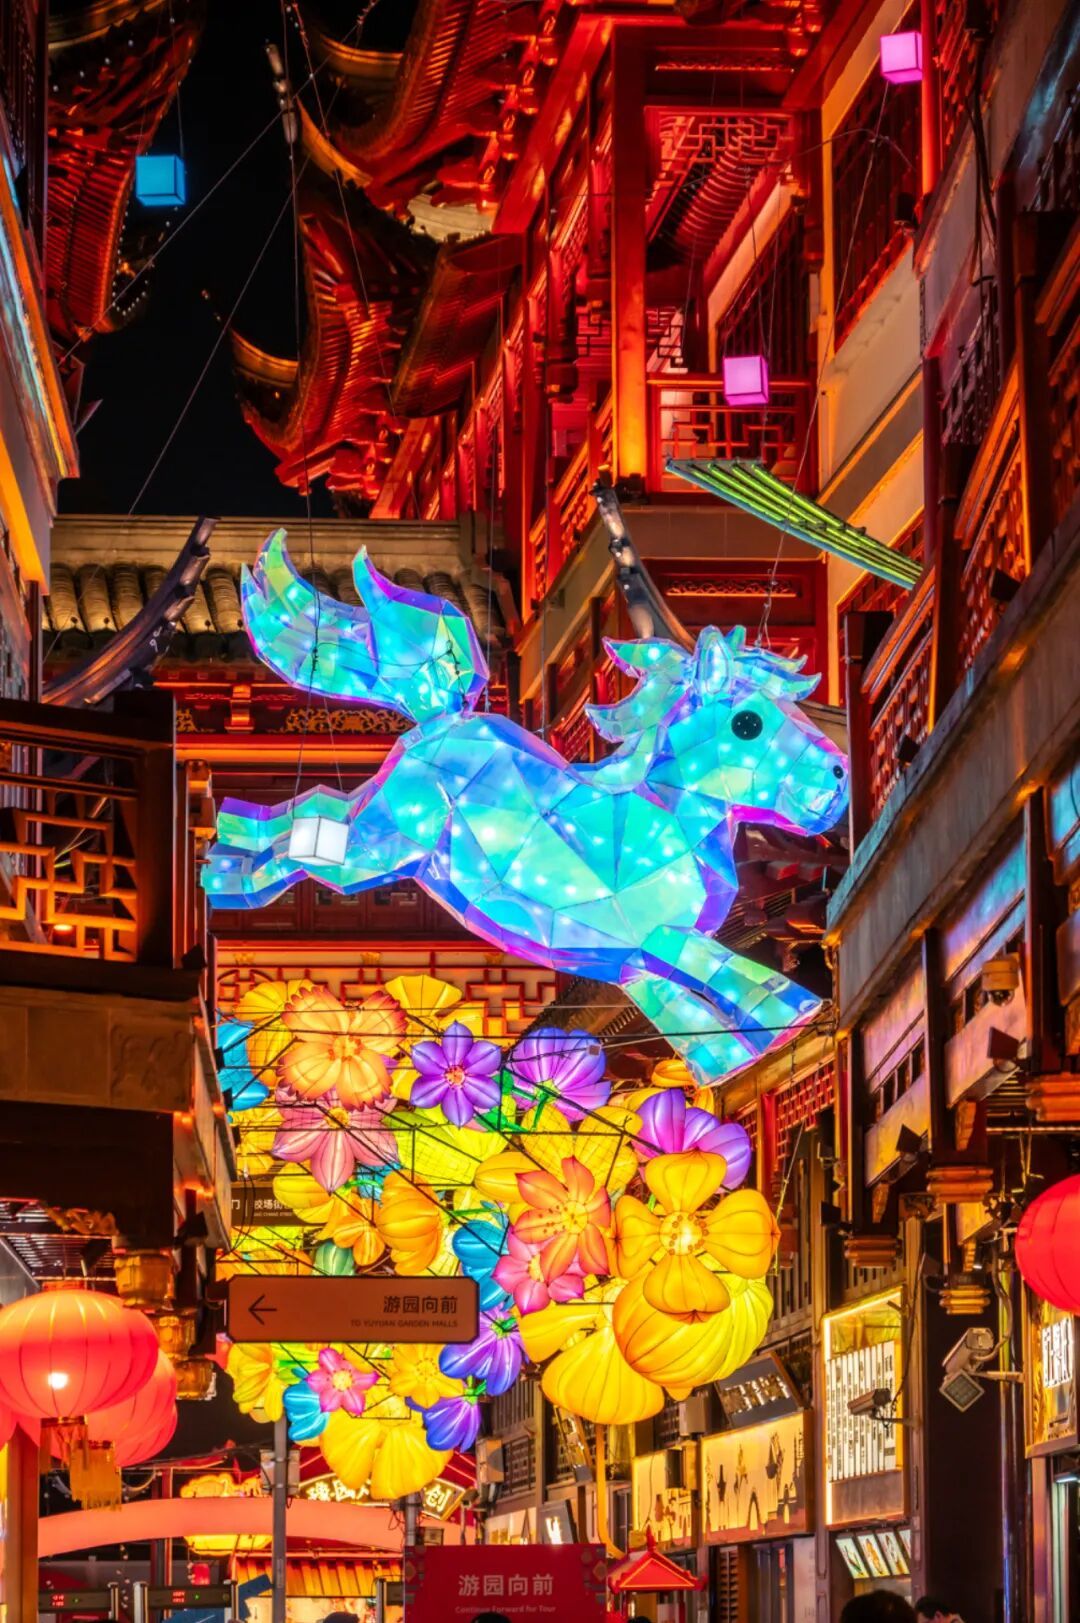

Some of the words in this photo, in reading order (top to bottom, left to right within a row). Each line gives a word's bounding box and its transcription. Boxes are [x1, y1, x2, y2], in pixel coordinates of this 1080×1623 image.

[383, 1295, 458, 1314] 游园向前
[350, 1319, 361, 1328] TO
[363, 1319, 396, 1328] YUYUAN
[397, 1319, 430, 1328] GARDEN
[458, 1573, 554, 1597] 游园向前
[455, 1606, 490, 1614] Continue
[491, 1605, 525, 1613] Forward
[526, 1604, 538, 1613] for
[539, 1604, 557, 1613] Tour
